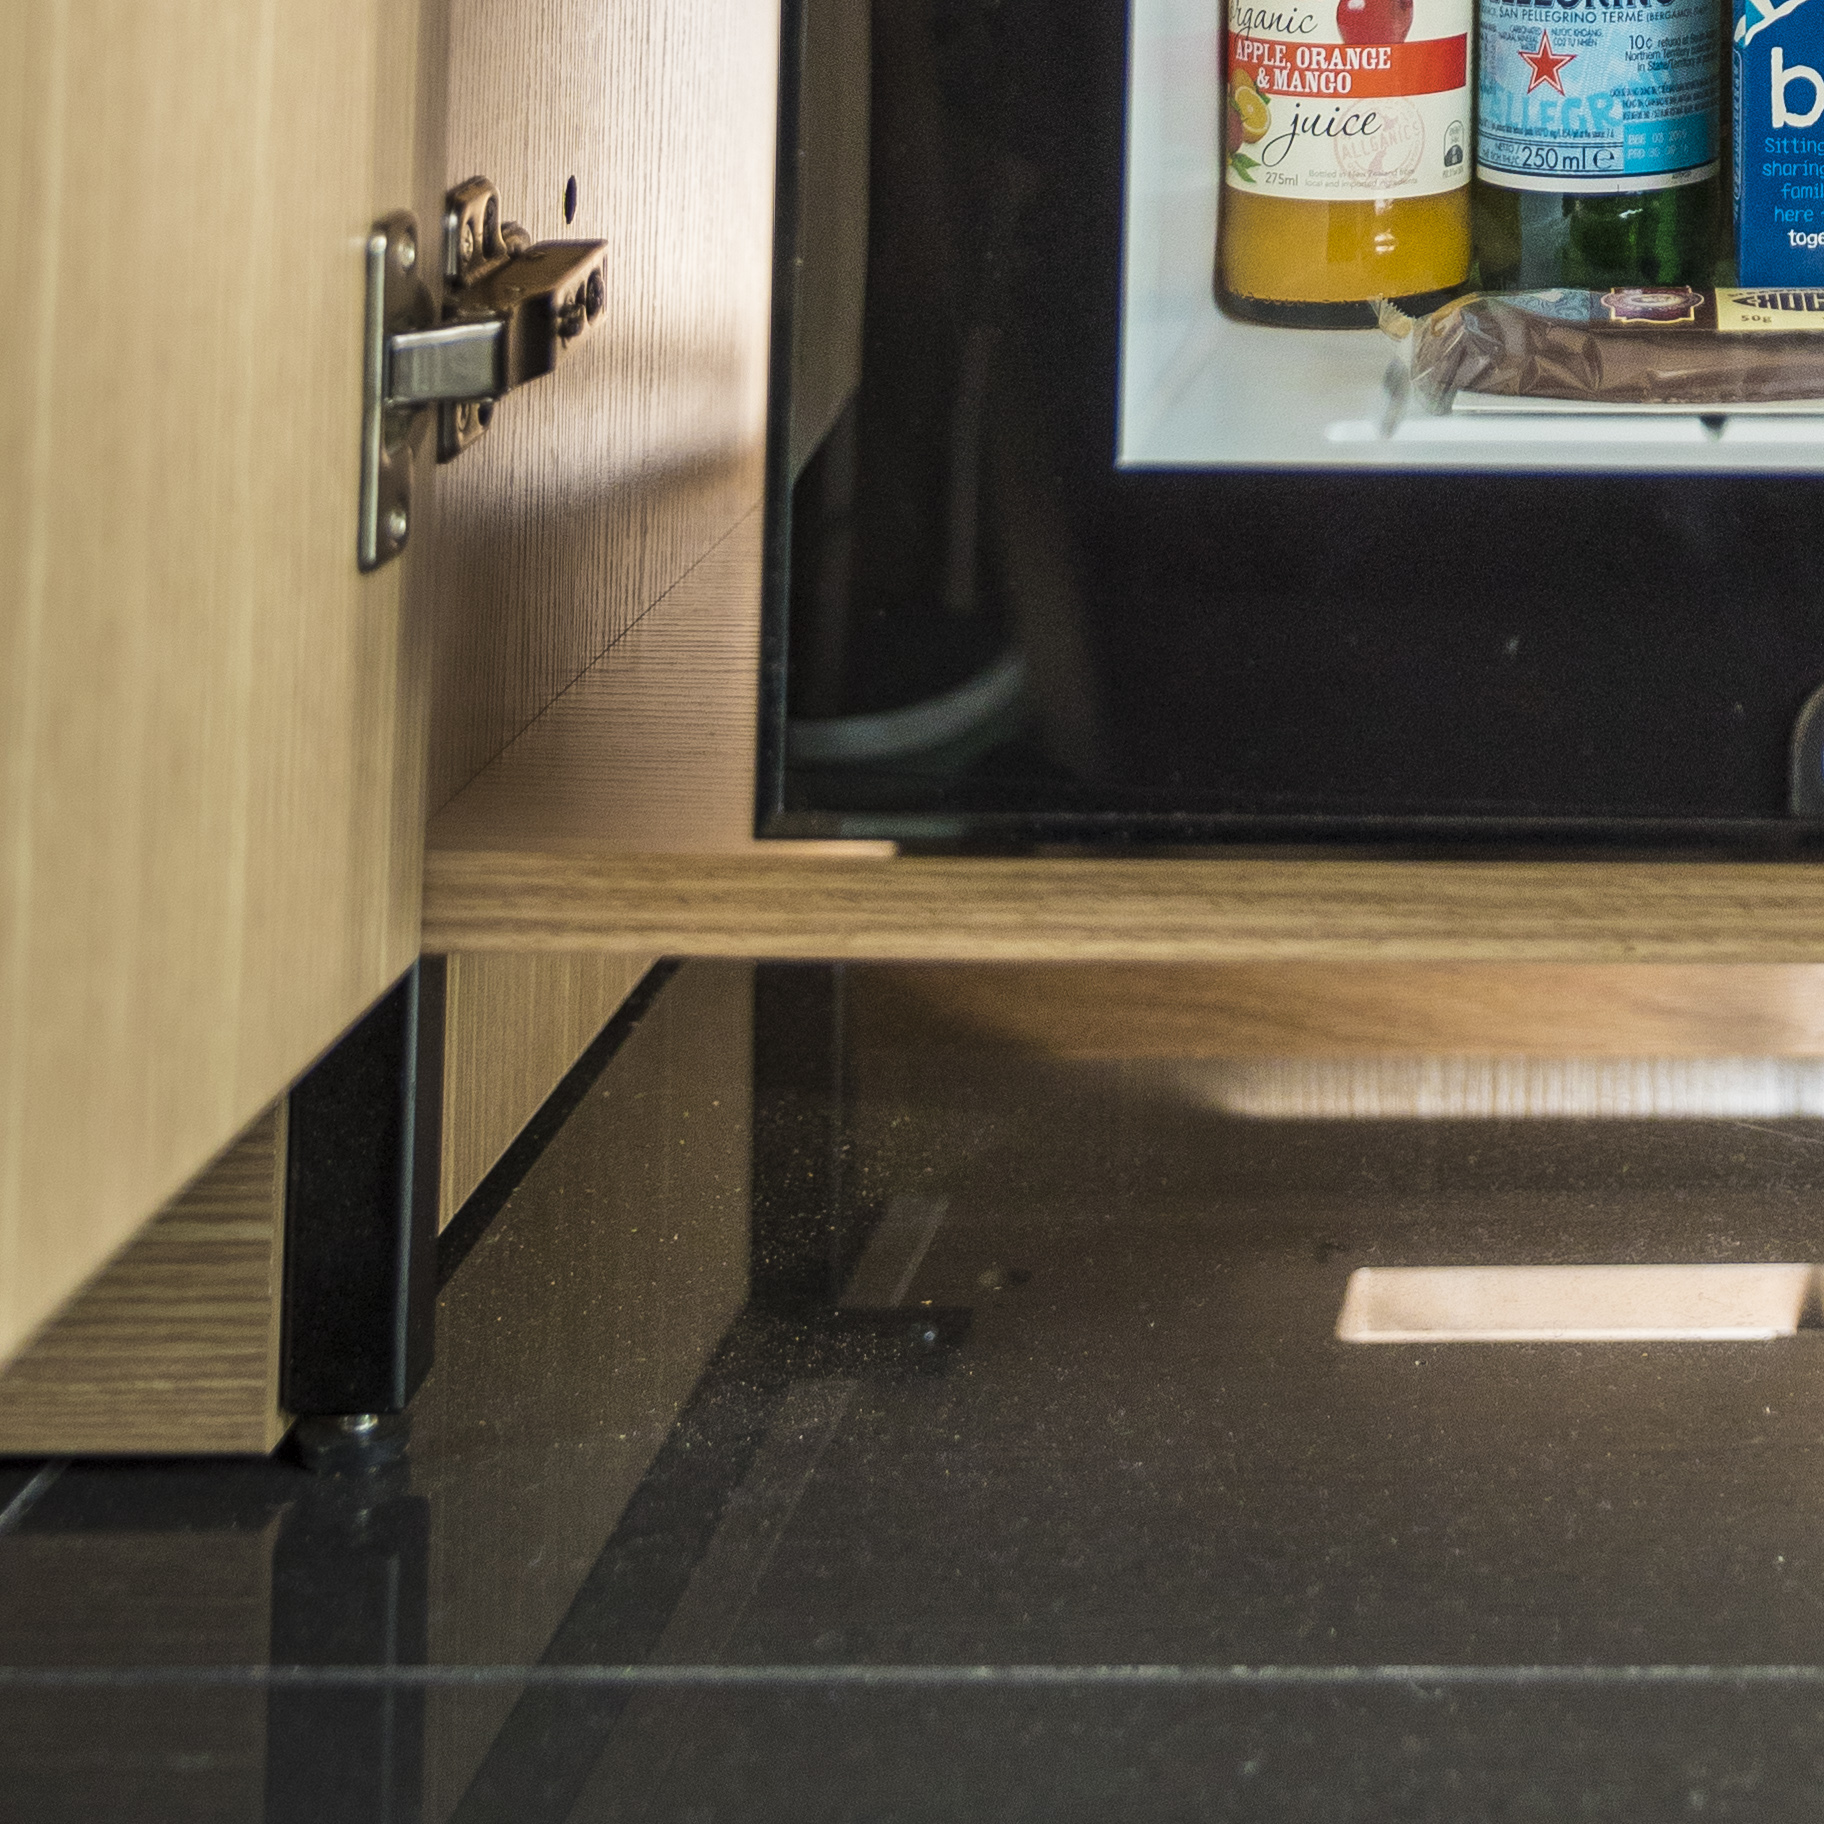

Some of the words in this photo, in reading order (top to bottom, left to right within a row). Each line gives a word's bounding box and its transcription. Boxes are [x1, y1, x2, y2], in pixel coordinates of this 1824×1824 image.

[1499, 7, 1518, 19] SAN
[1522, 8, 1597, 24] PELLEGRINO
[1601, 10, 1644, 24] TERME
[1235, 44, 1293, 72] APPLE,
[1295, 46, 1392, 70] ORANGE
[1256, 67, 1270, 90] &
[1273, 67, 1352, 94] MANGO
[1261, 102, 1383, 168] juice
[1522, 146, 1558, 168] 250
[1562, 147, 1586, 170] ml
[1264, 170, 1299, 187] 275ml
[1773, 205, 1815, 223] here
[1740, 314, 1772, 324] 50g
